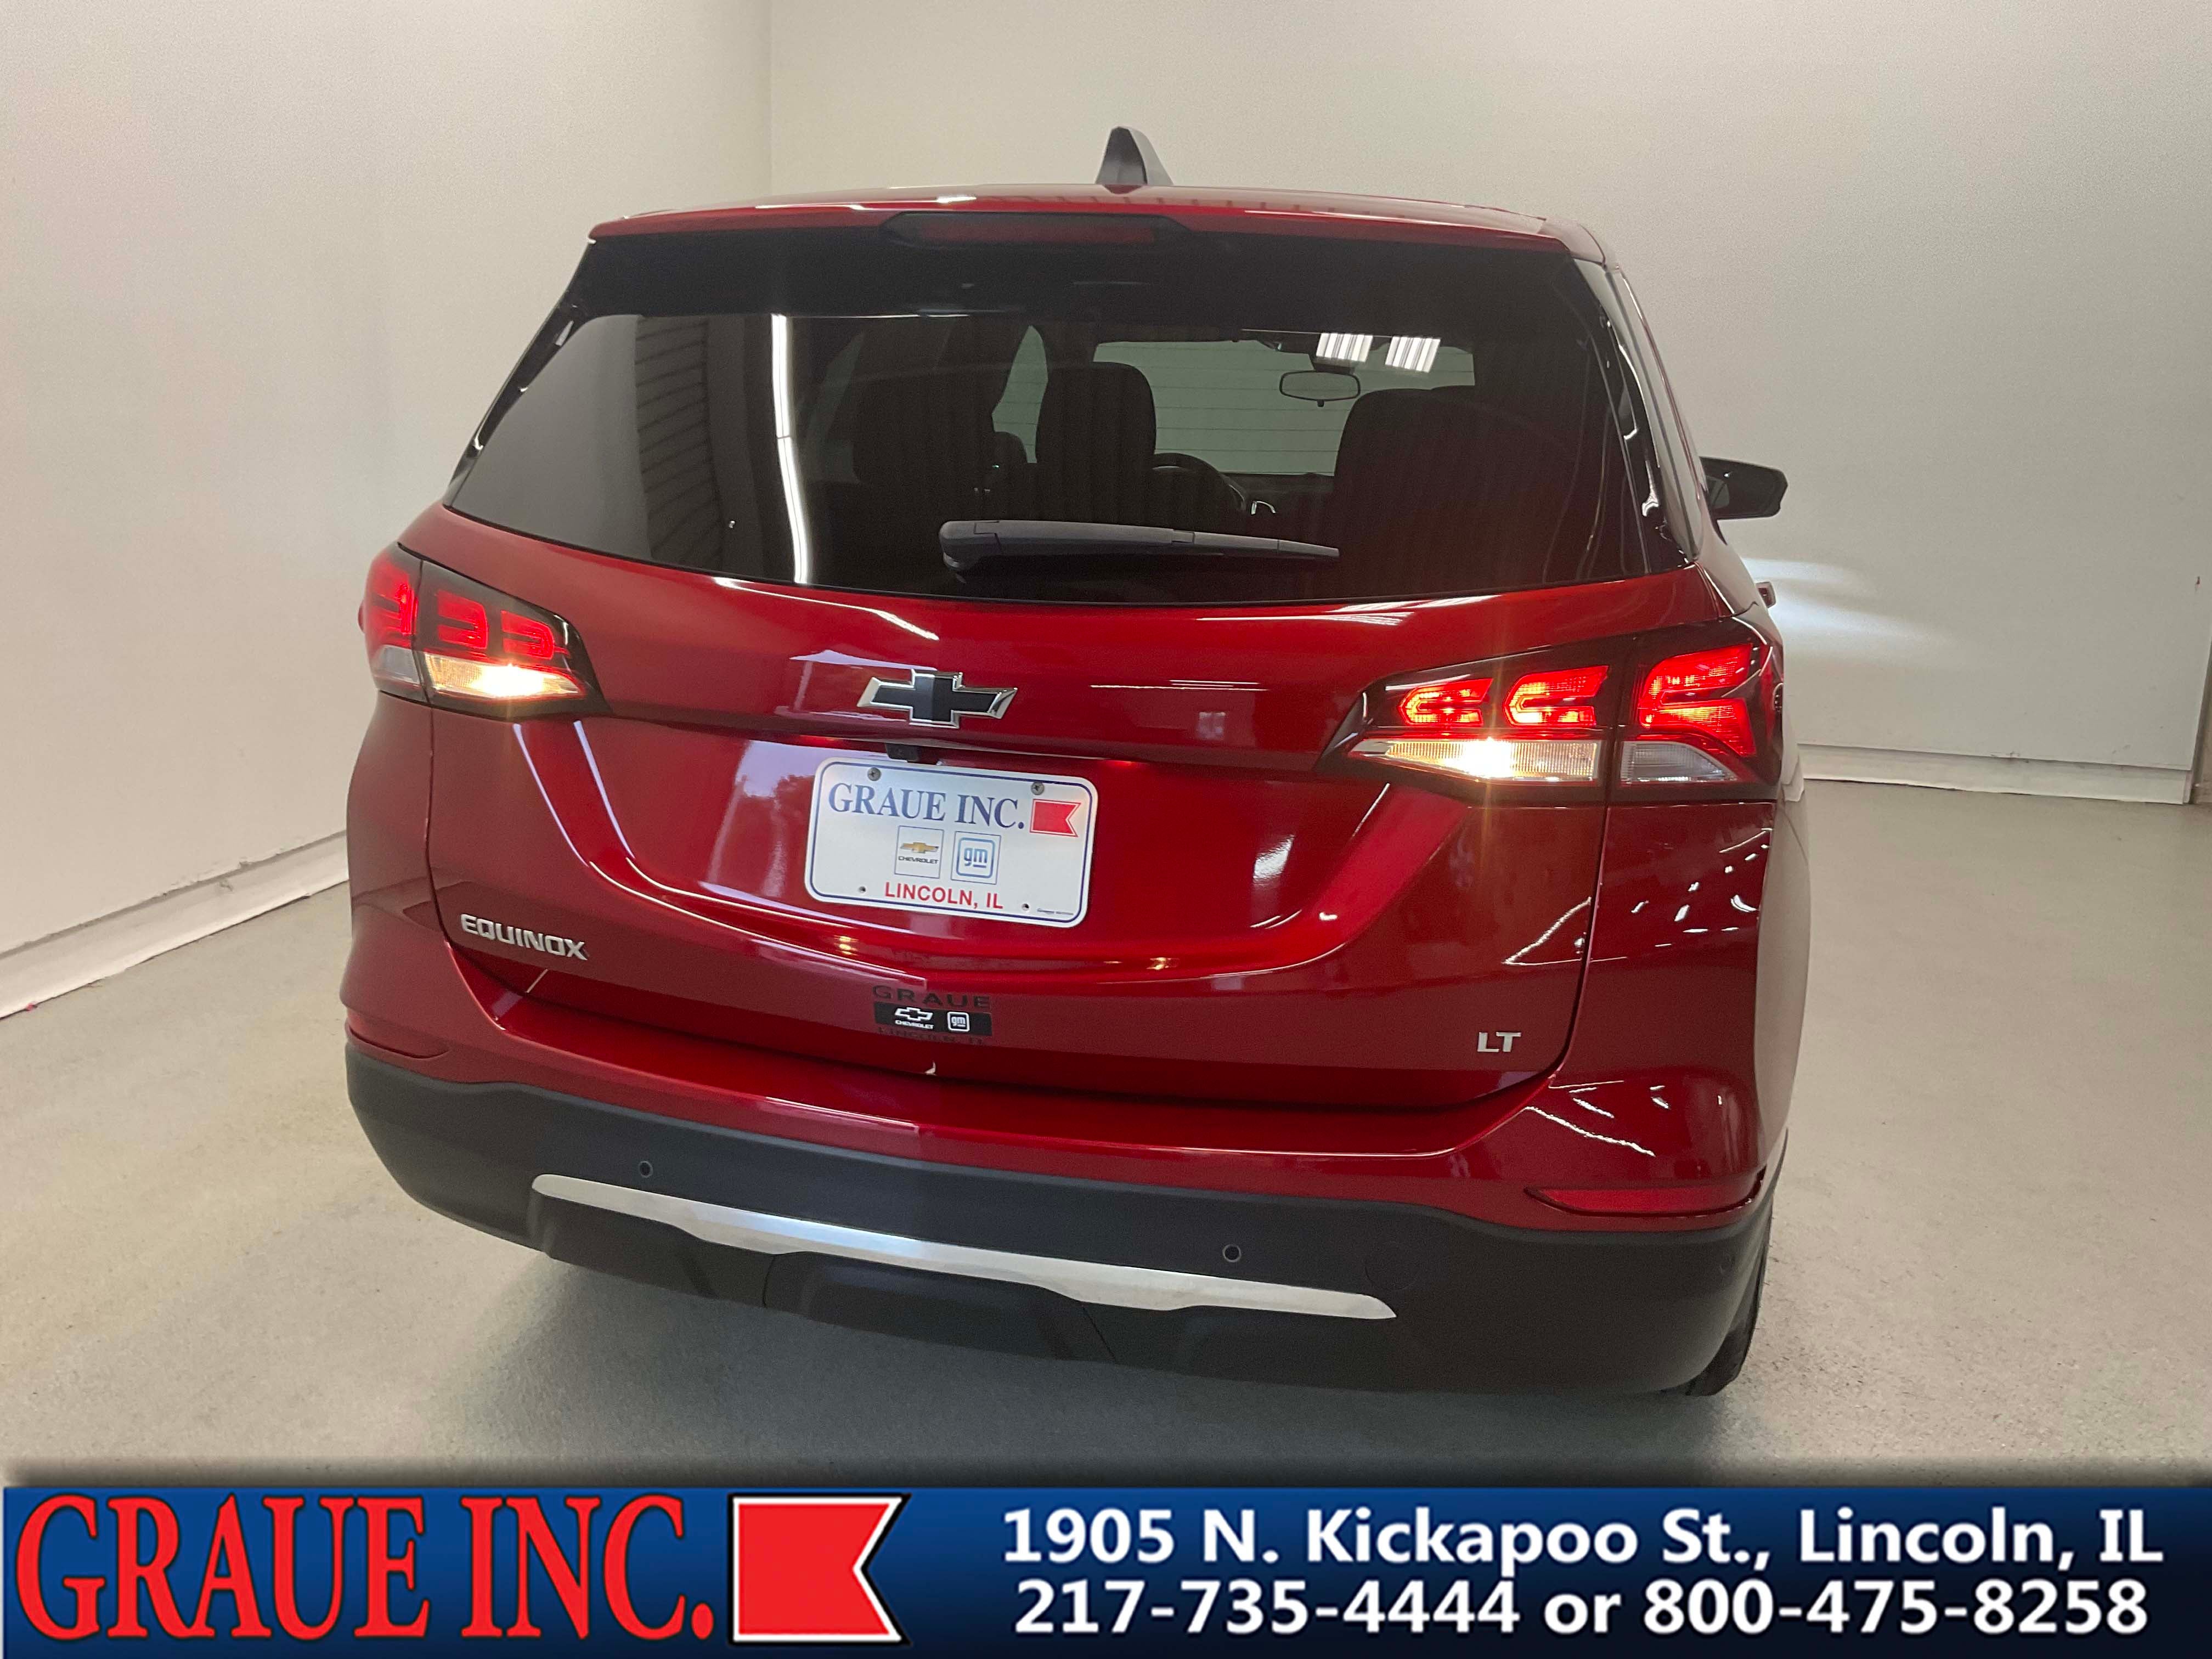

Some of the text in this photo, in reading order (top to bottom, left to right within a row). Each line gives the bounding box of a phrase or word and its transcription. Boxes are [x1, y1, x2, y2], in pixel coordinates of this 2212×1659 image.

[828, 782, 1024, 829] GRAUE INC.
[898, 855, 939, 864] CHEVROLET
[963, 847, 988, 868] gm
[885, 882, 1003, 909] LINCOLN, IL
[460, 913, 588, 961] EQUINOX
[872, 985, 991, 1008] GRAUE
[895, 1019, 934, 1029] CHEVROLET
[951, 1016, 966, 1027] gm
[1477, 1031, 1522, 1052] LT
